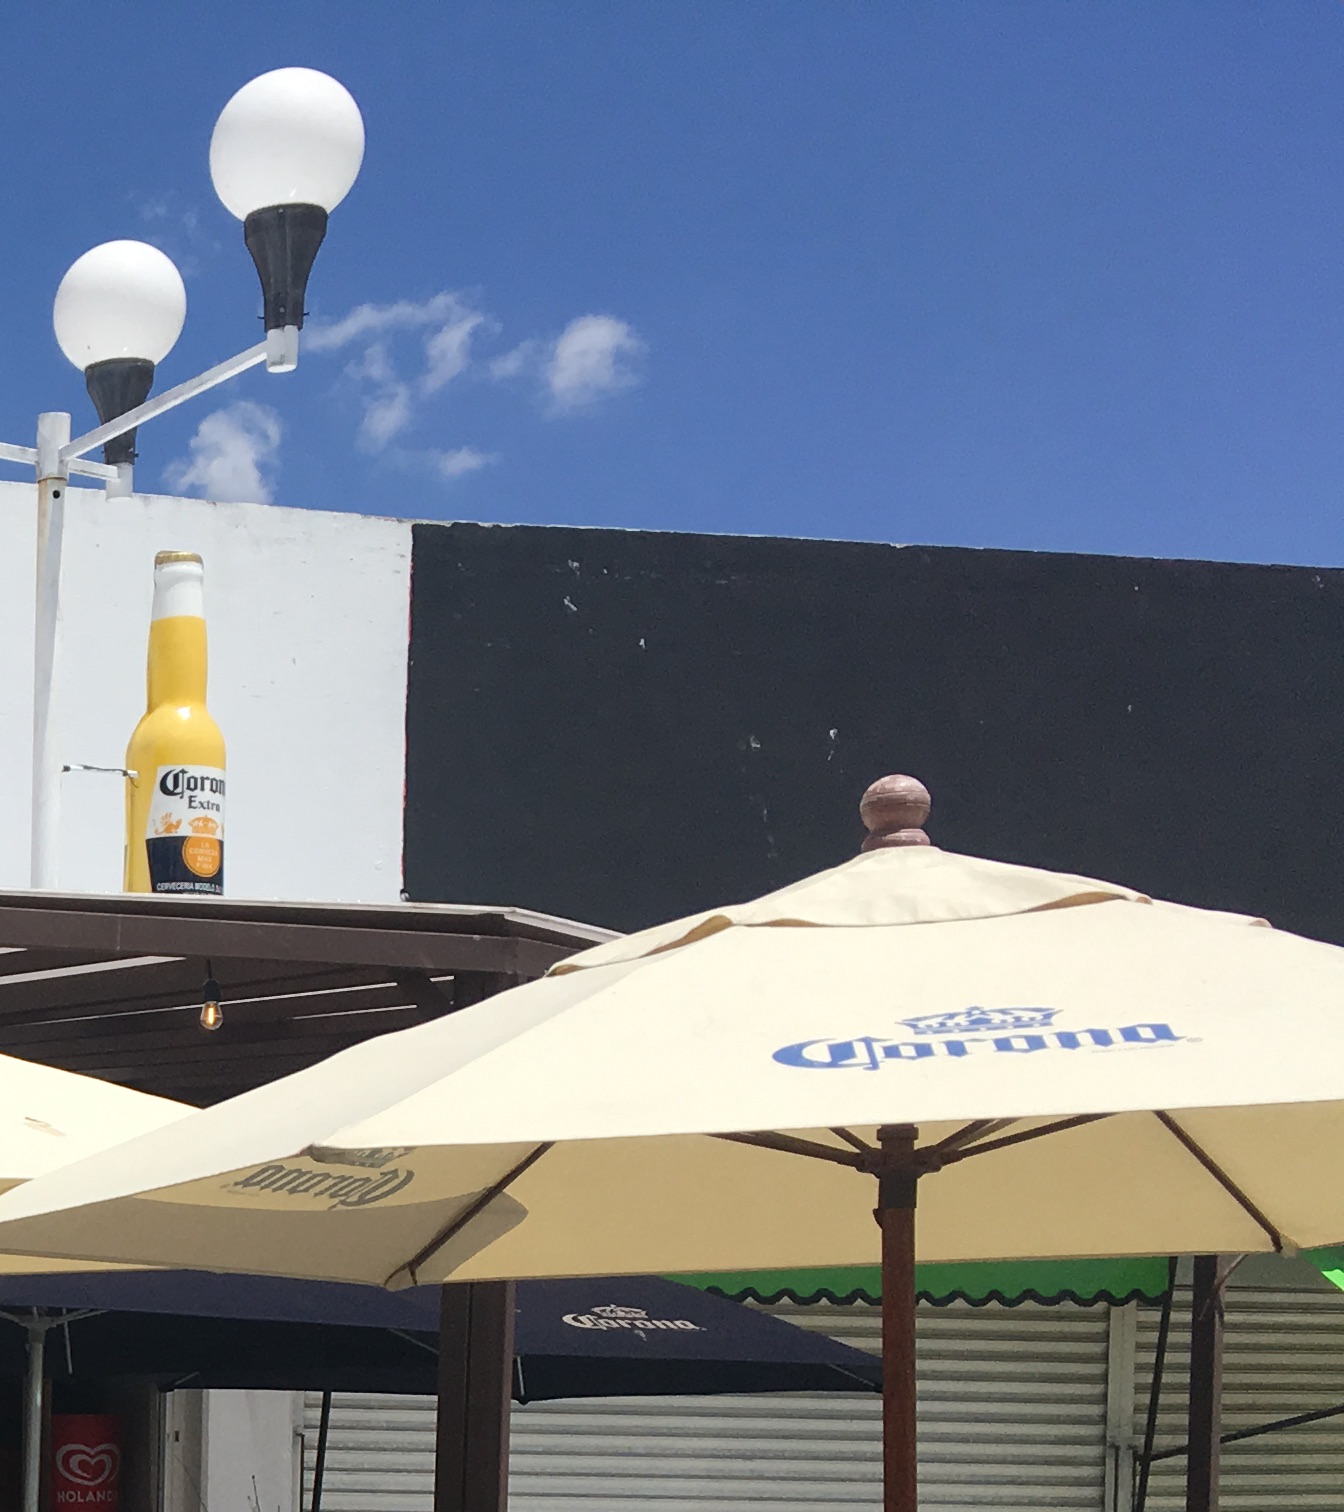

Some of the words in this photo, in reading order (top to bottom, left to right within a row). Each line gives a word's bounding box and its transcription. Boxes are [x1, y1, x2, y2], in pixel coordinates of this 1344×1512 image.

[159, 768, 226, 799] Coron
[187, 795, 221, 812] Extra
[771, 1024, 1188, 1070] Corona
[562, 1313, 700, 1330] Corona
